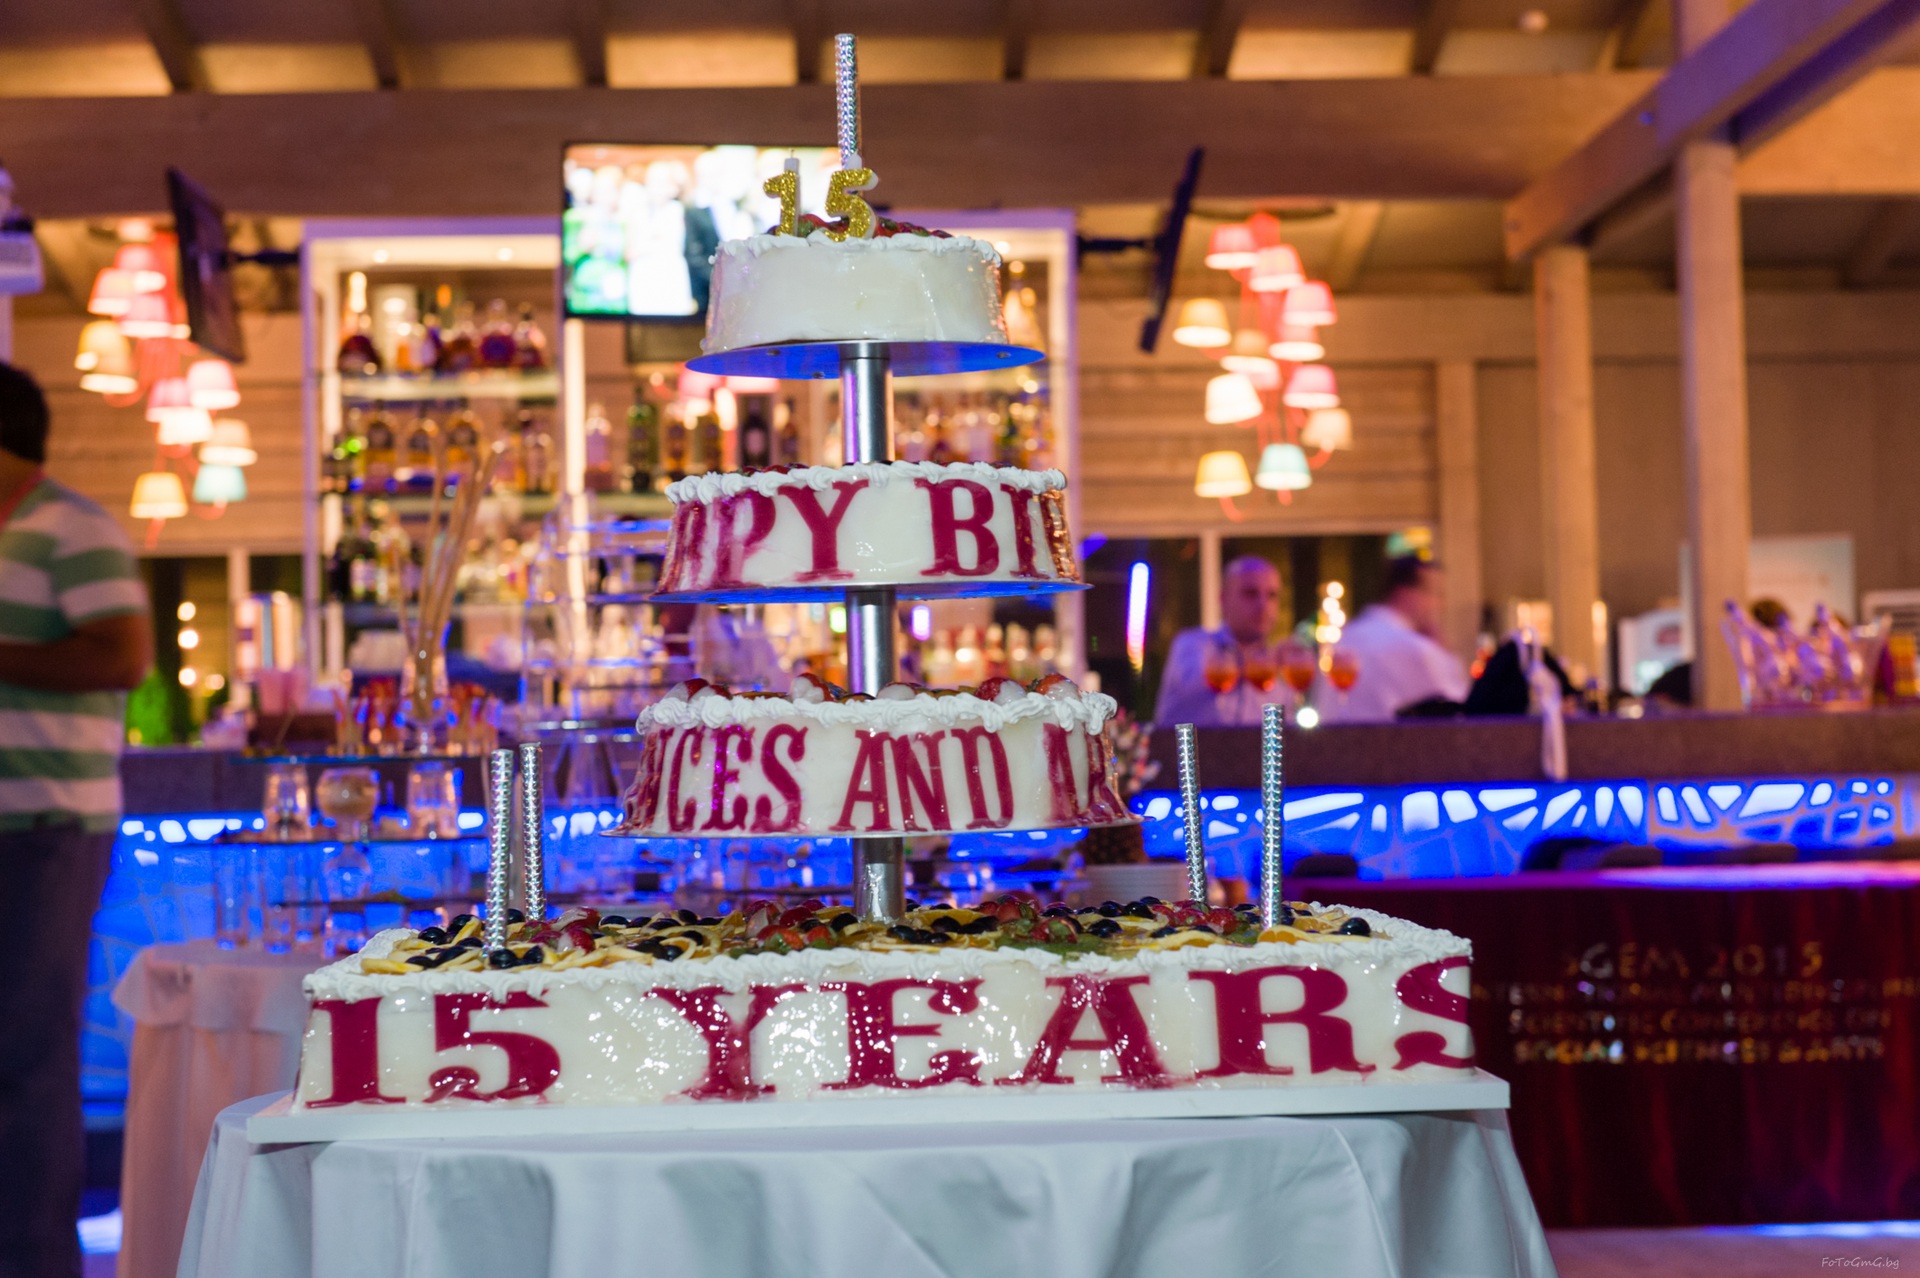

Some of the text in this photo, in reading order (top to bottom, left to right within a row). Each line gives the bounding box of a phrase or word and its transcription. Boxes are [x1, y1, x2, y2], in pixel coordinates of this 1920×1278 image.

[763, 167, 878, 242] 15
[828, 724, 1014, 831] AND
[303, 955, 1475, 1108] 15 YEARS
